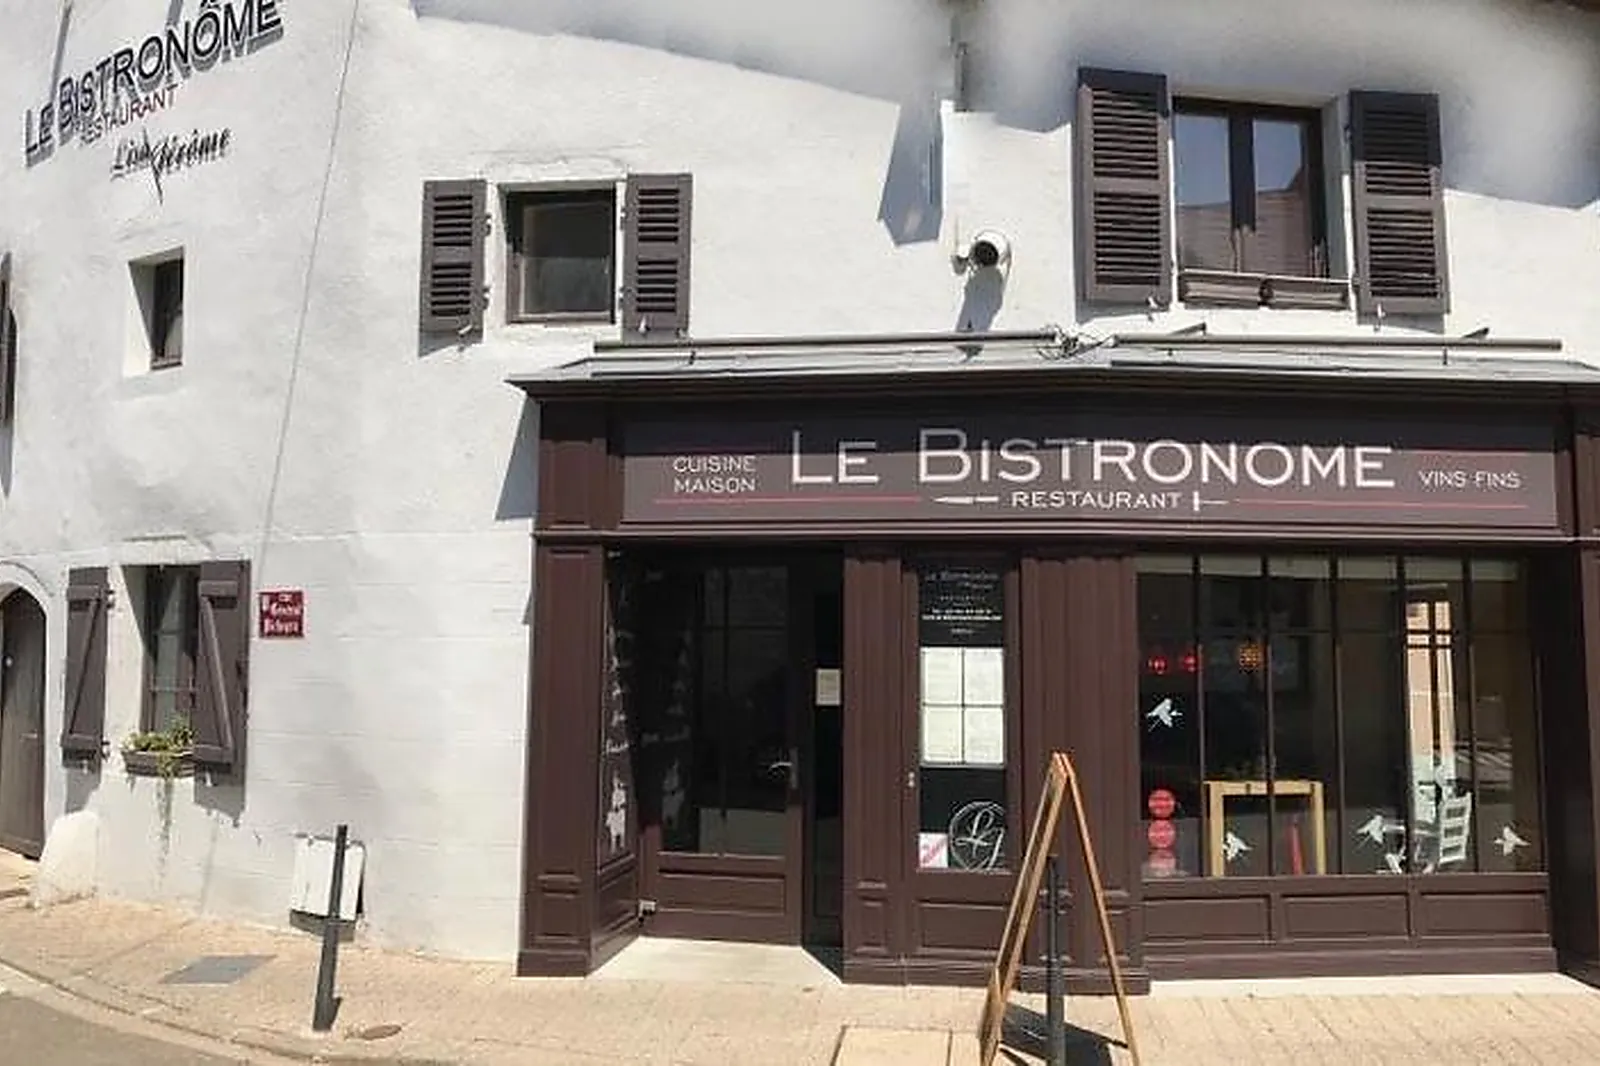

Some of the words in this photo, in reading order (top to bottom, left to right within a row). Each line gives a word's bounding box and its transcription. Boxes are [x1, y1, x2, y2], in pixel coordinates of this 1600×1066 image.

[672, 455, 757, 473] CUISINE
[673, 476, 757, 494] MAISON
[1418, 469, 1467, 489] VINS
[1474, 470, 1522, 490] FINS
[1011, 490, 1183, 510] RESTAURANT
